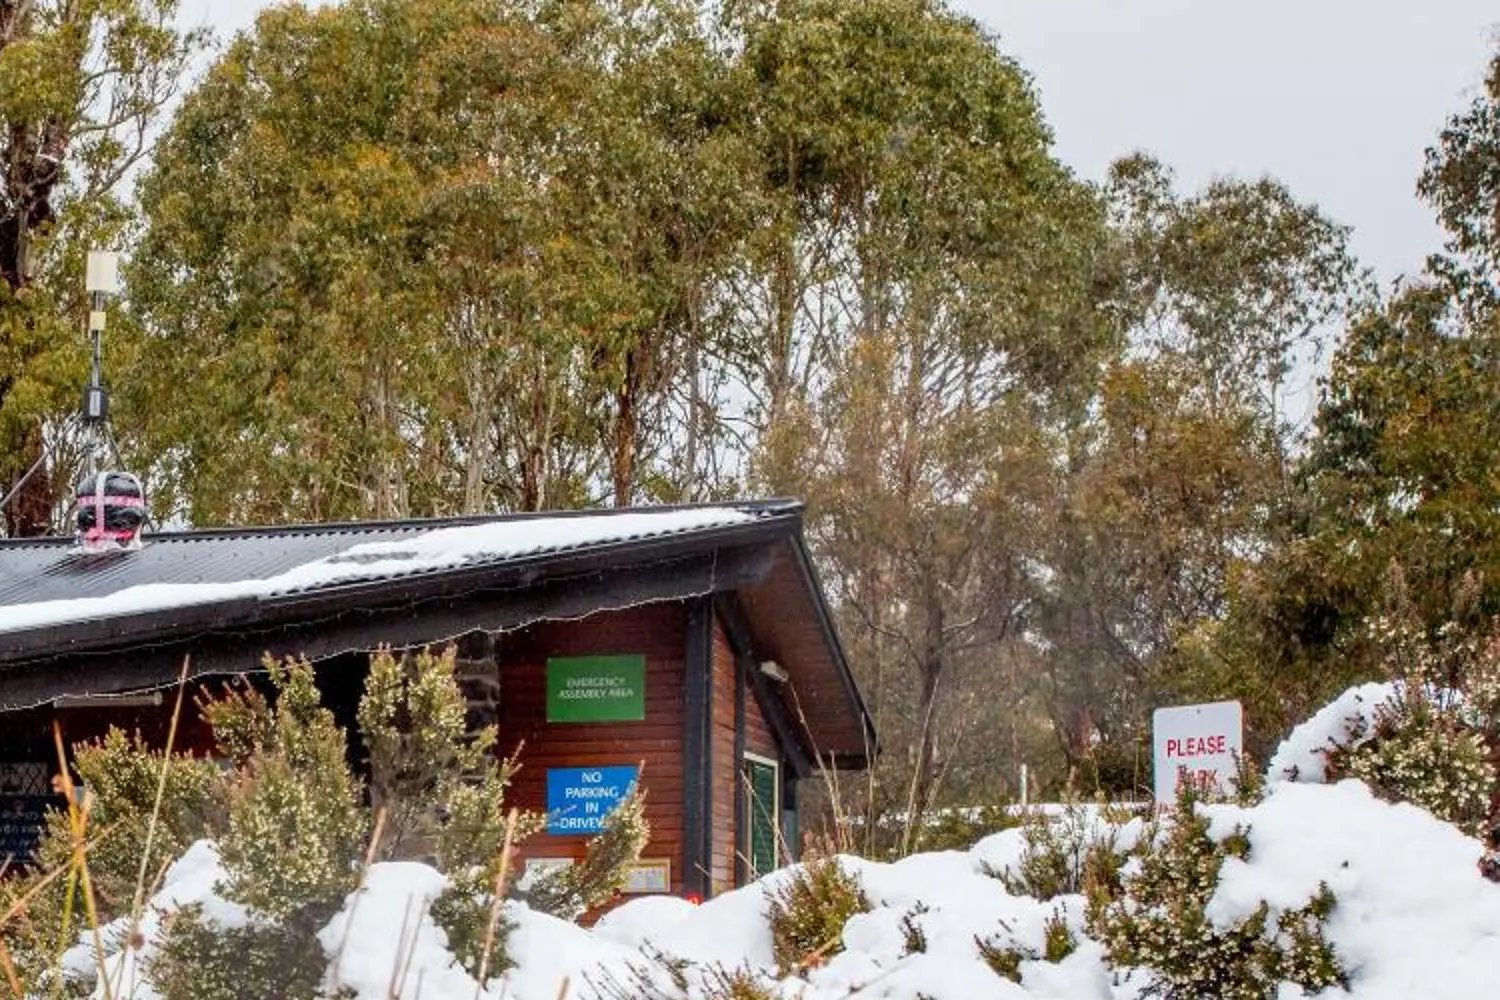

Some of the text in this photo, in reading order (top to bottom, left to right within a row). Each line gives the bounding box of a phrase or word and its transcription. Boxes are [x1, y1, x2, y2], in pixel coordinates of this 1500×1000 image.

[566, 677, 626, 688] EMERGENCY
[558, 687, 634, 699] ASSEMBLY AREA
[1167, 735, 1225, 757] PLEASE
[581, 771, 602, 783] NO
[565, 786, 619, 799] PARKING
[585, 801, 599, 814] IN
[560, 815, 605, 829] DRIVE
